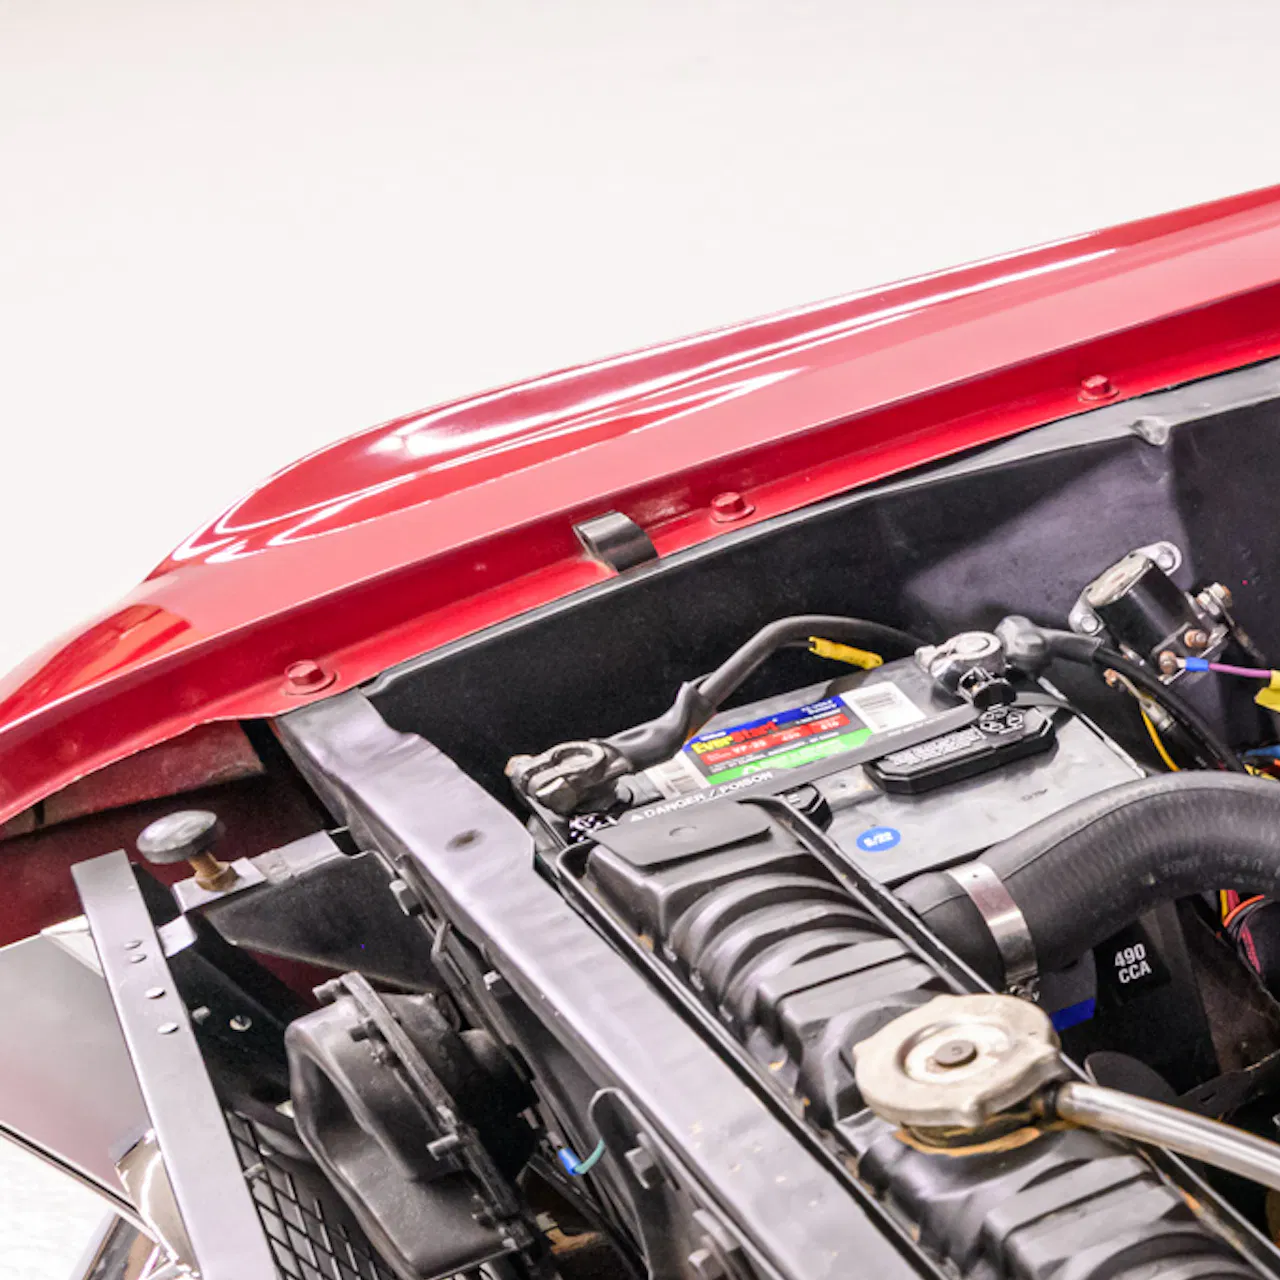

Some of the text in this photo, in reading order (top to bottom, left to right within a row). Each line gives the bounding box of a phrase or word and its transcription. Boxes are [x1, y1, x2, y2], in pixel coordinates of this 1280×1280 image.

[643, 794, 704, 818] DANGER
[719, 772, 774, 796] POISON
[1114, 943, 1146, 967] 490
[1118, 960, 1152, 983] CCA
